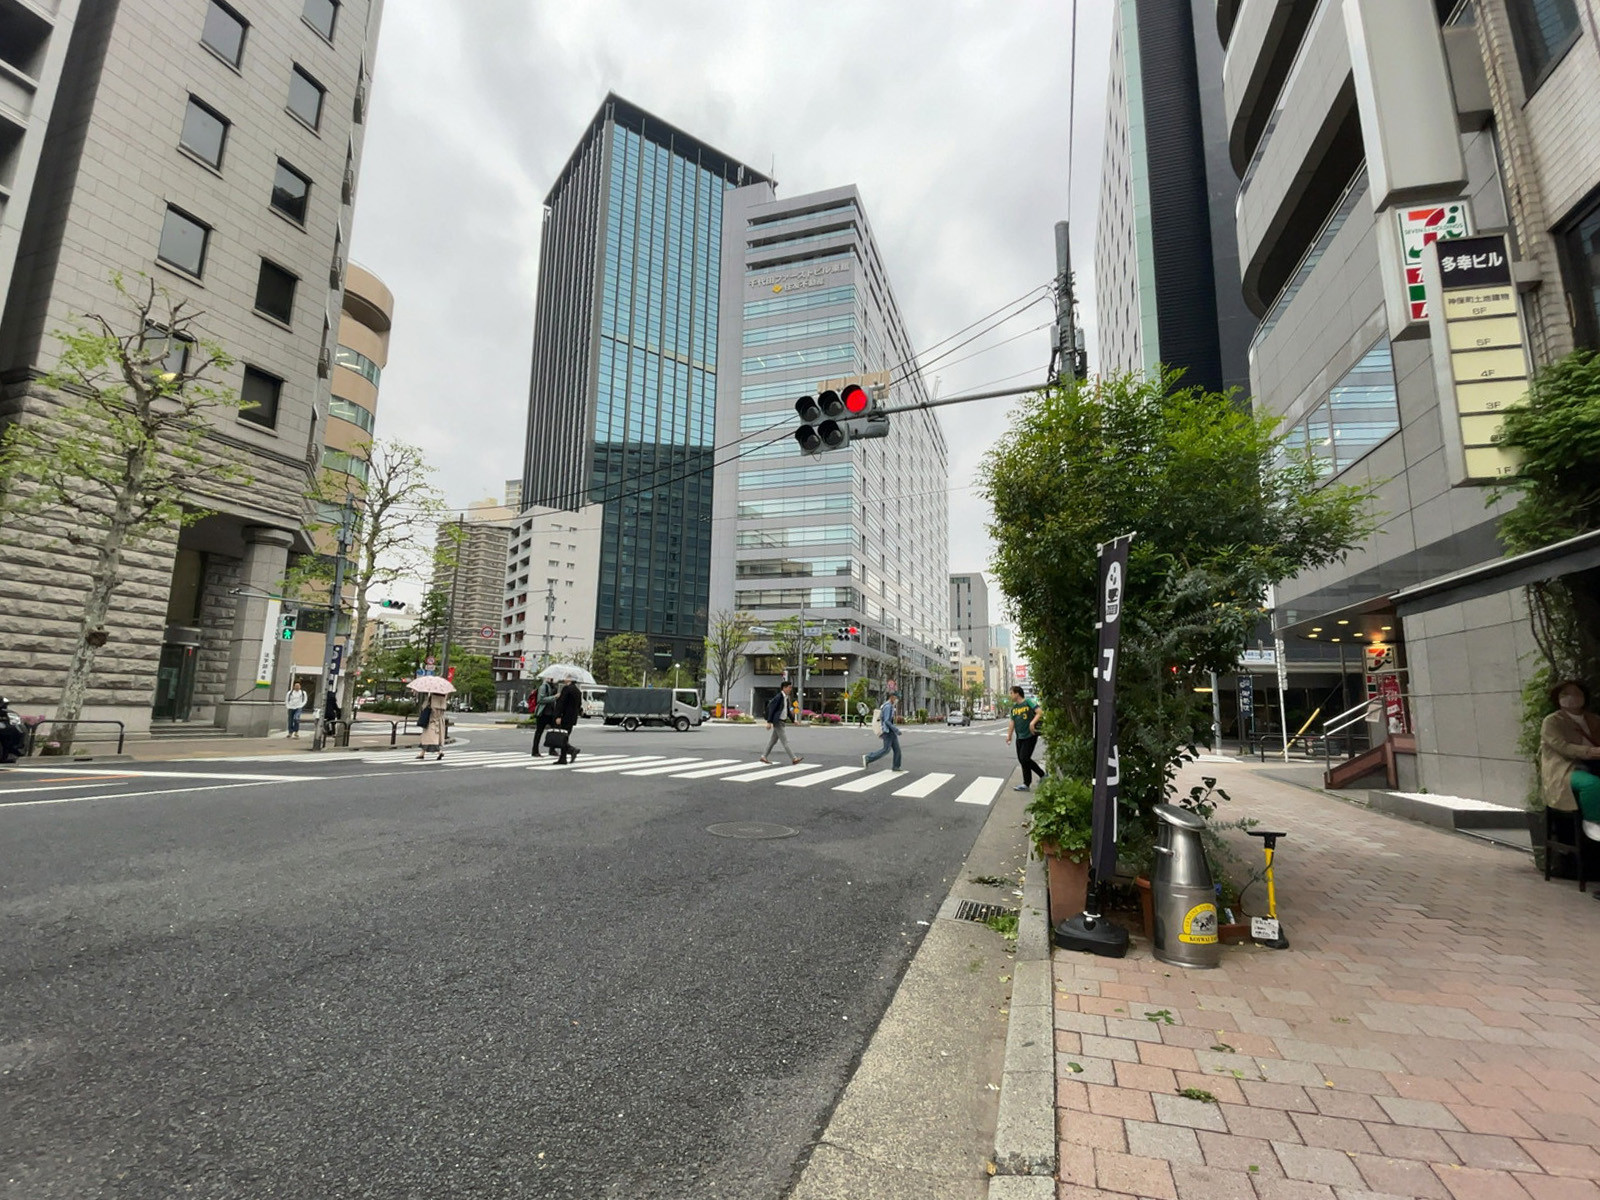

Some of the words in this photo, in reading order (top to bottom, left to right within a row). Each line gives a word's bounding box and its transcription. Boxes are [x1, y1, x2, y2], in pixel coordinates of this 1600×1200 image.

[1441, 252, 1503, 272] 多幸ビル
[1476, 338, 1491, 346] 5F
[1480, 369, 1495, 378] 4F
[1486, 401, 1501, 409] 3F
[1496, 466, 1511, 474] 1F
